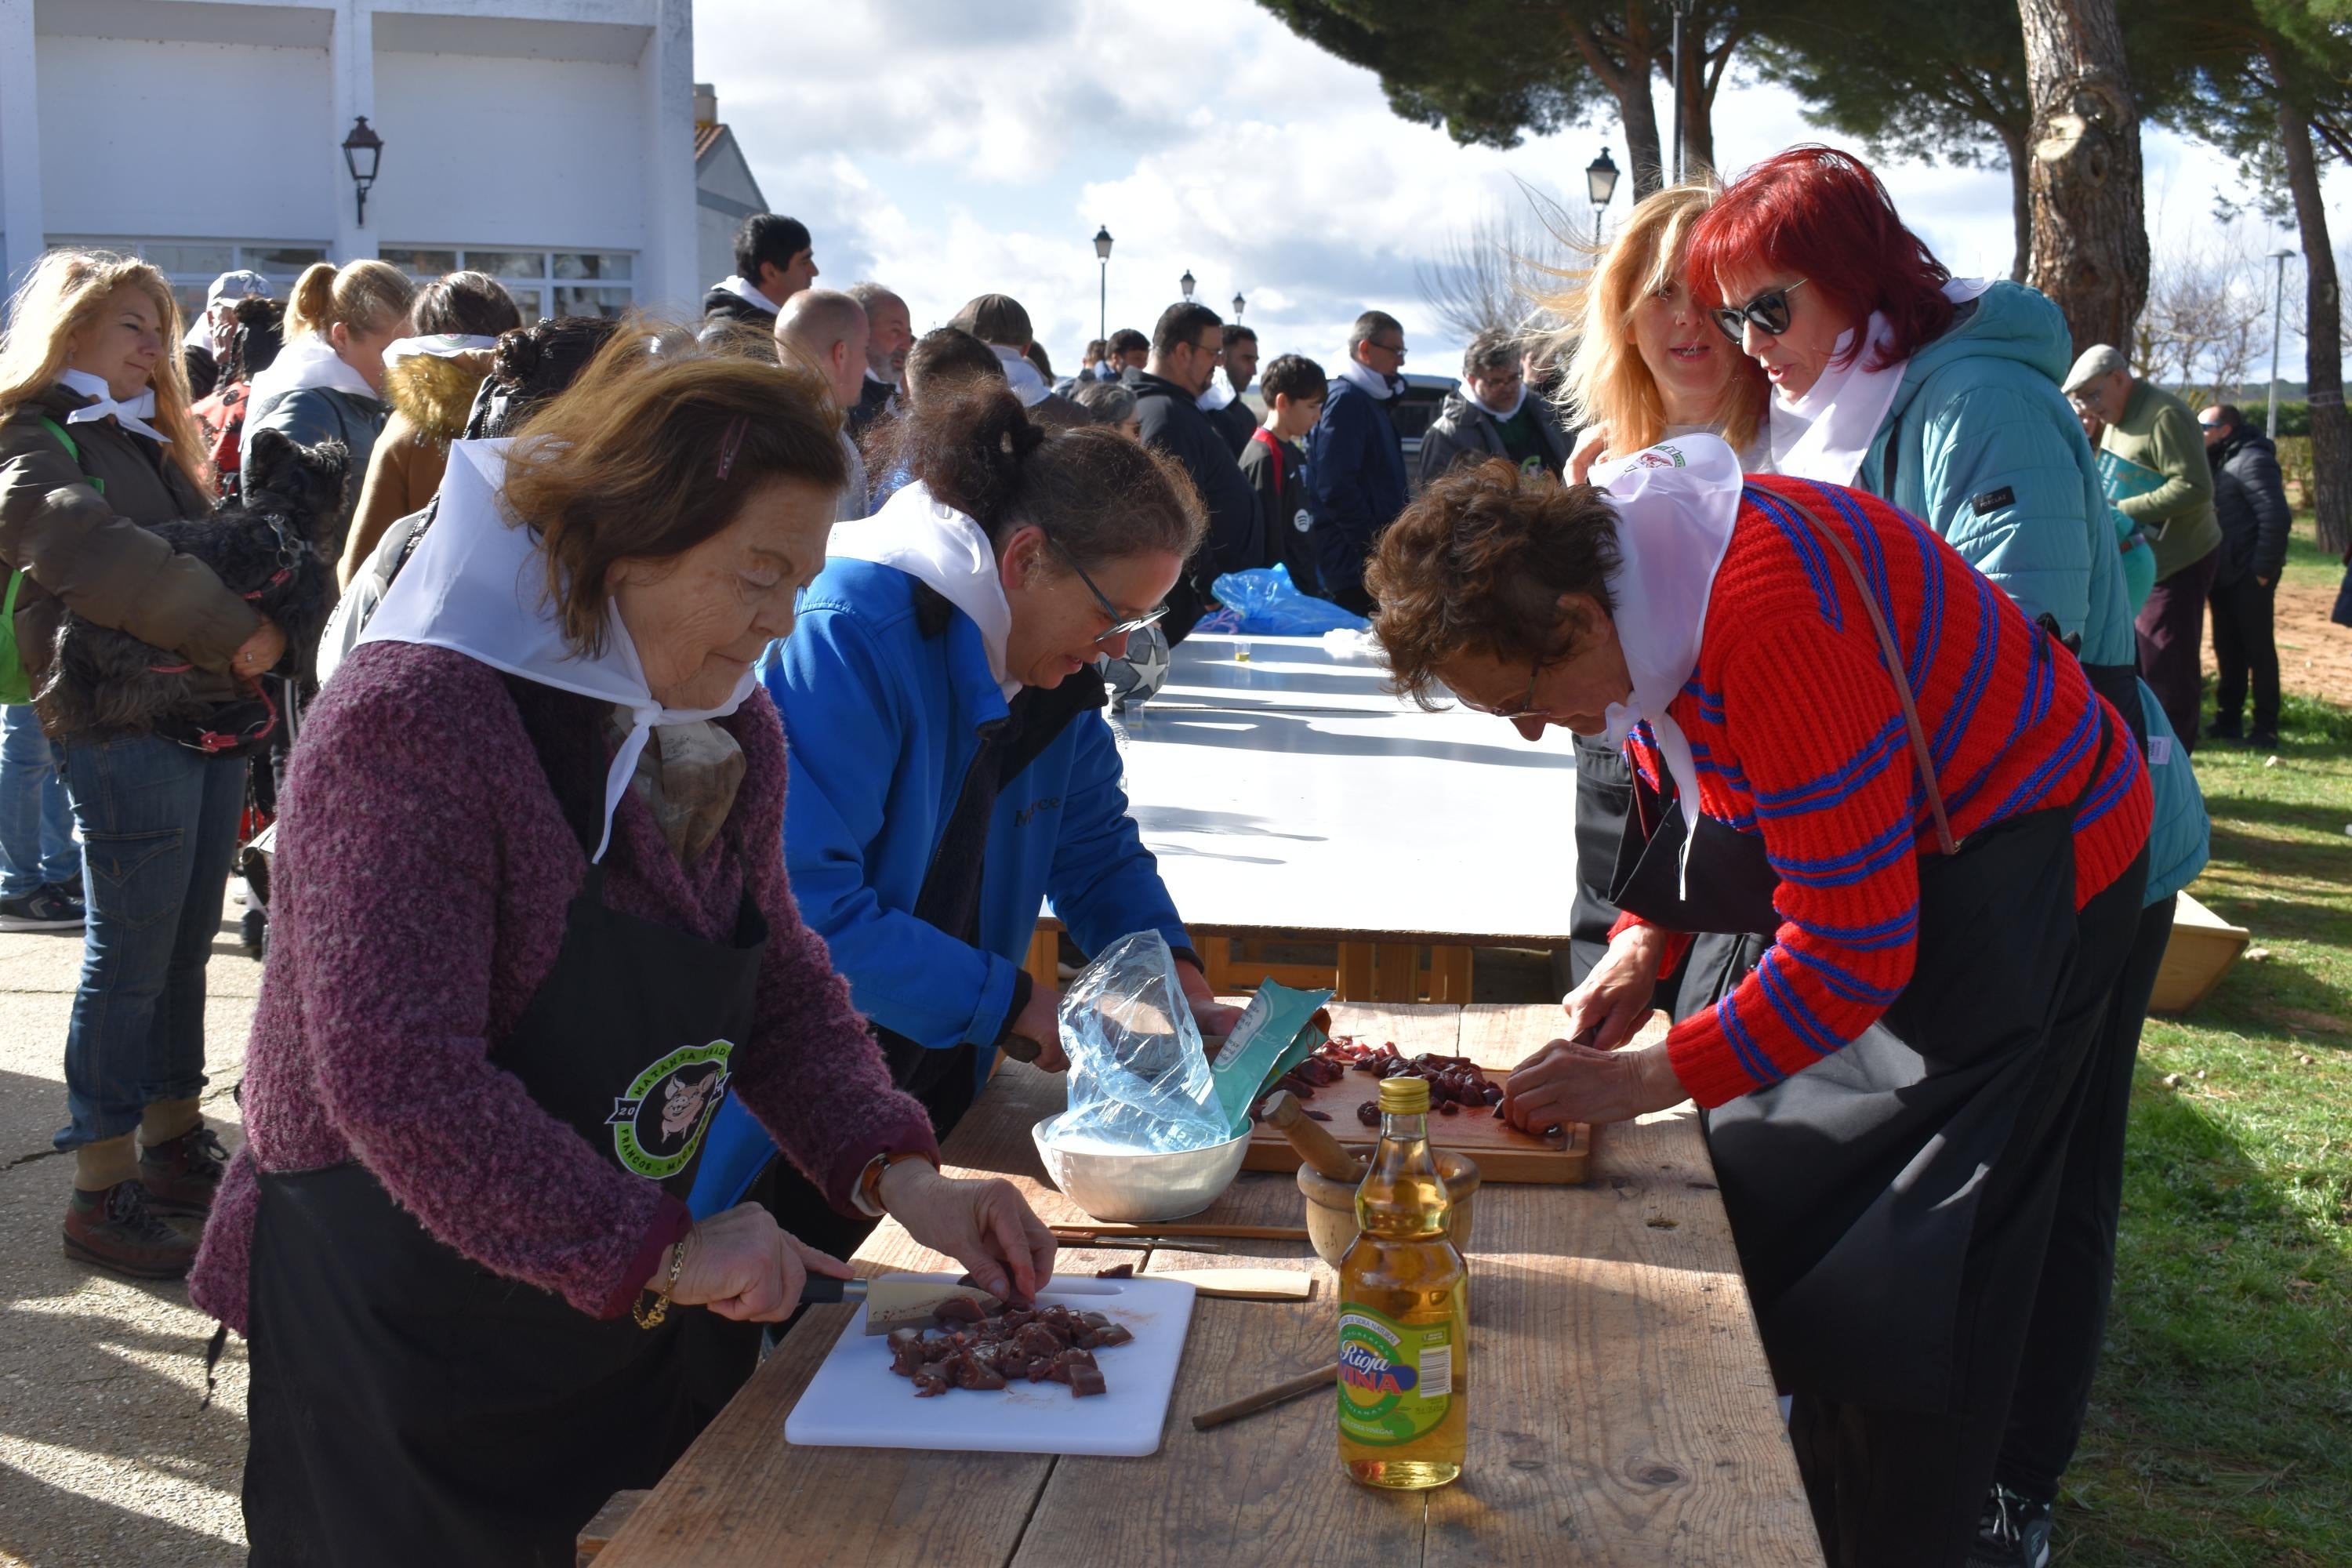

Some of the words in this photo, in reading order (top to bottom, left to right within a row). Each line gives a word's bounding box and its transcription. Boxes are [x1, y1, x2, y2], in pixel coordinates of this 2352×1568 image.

[634, 1051, 696, 1096] MATANZA
[618, 1107, 636, 1116] 20
[621, 1128, 652, 1171] FRANCOS
[1370, 1323, 1398, 1344] NATURAL
[1339, 1340, 1392, 1374] Rioja
